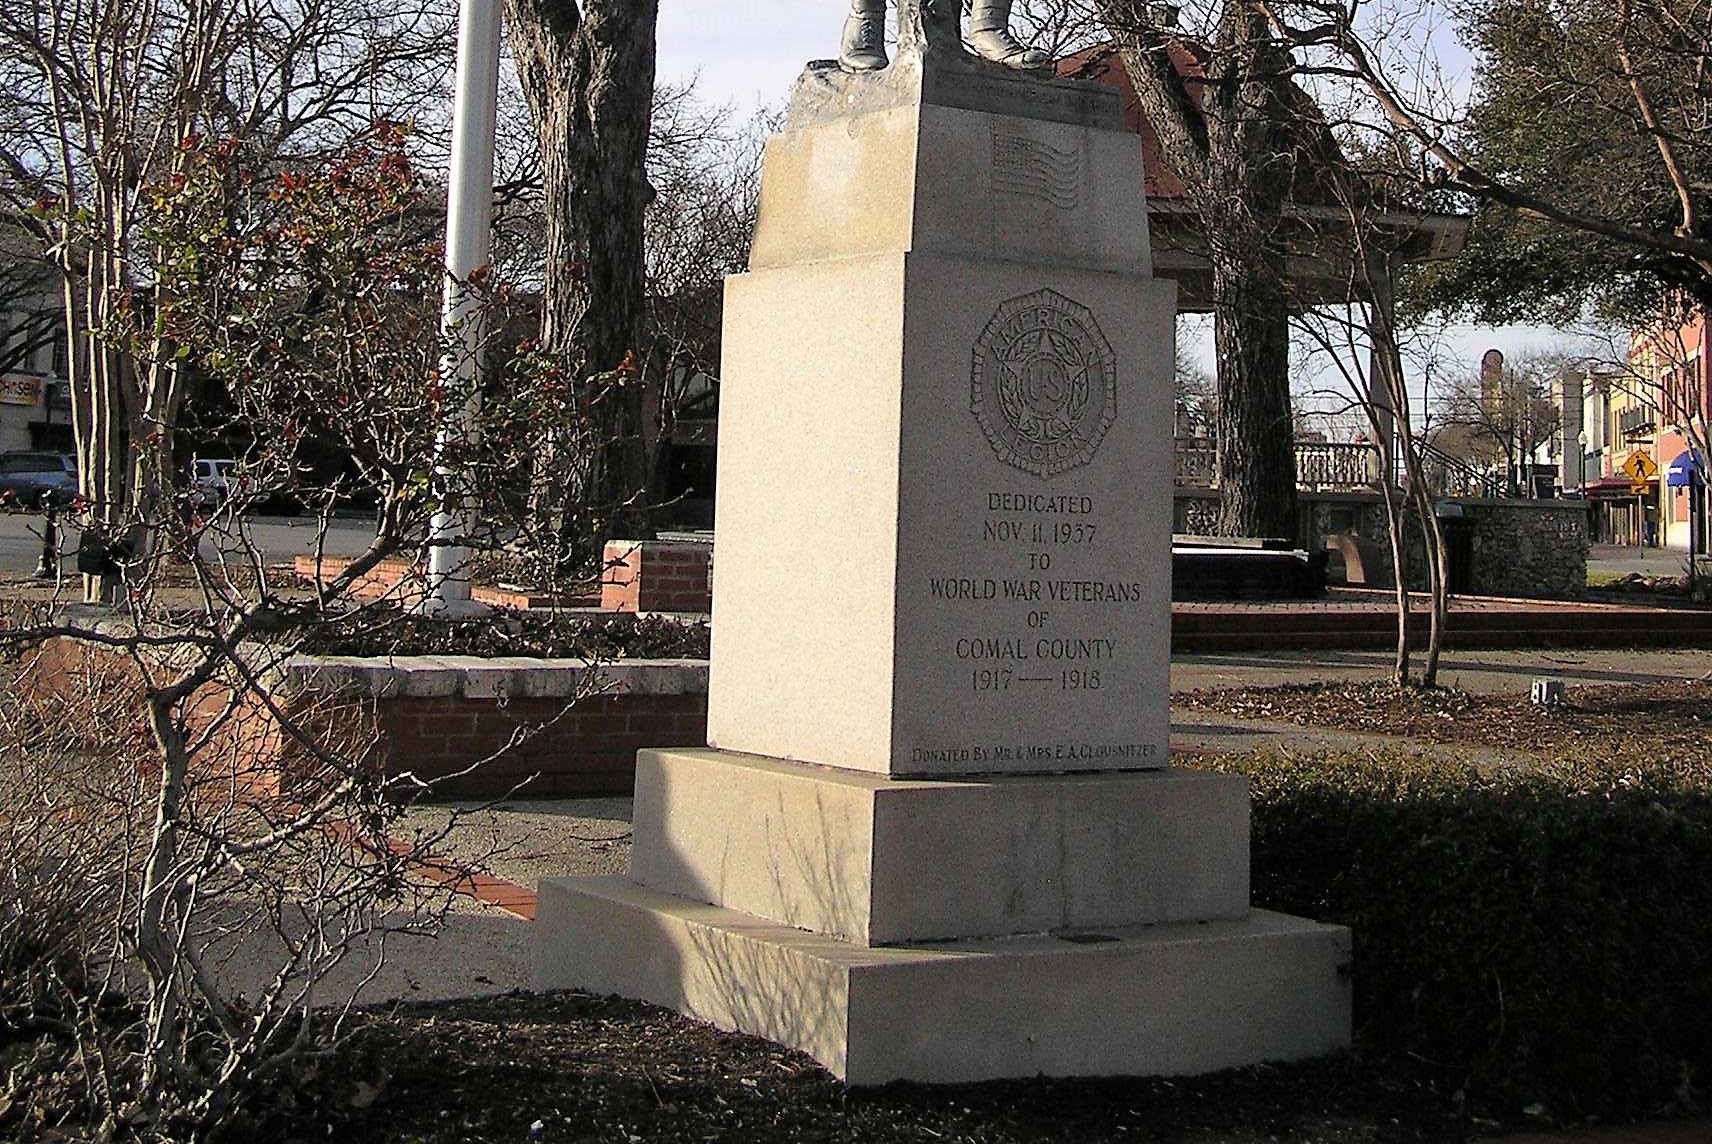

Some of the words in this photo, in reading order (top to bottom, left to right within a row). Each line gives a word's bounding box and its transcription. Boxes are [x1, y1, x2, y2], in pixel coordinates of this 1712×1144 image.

[997, 420, 1092, 461] LEGION
[988, 492, 1093, 514] DEDICATED
[1028, 553, 1050, 570] TO
[930, 577, 996, 600] WORLD
[1002, 579, 1041, 601] WAR
[1047, 580, 1141, 602] VETERANS
[1027, 611, 1049, 628] OF
[956, 638, 1028, 660] COMAL
[1036, 639, 1117, 660] COUNTY
[971, 668, 1014, 691] 1917
